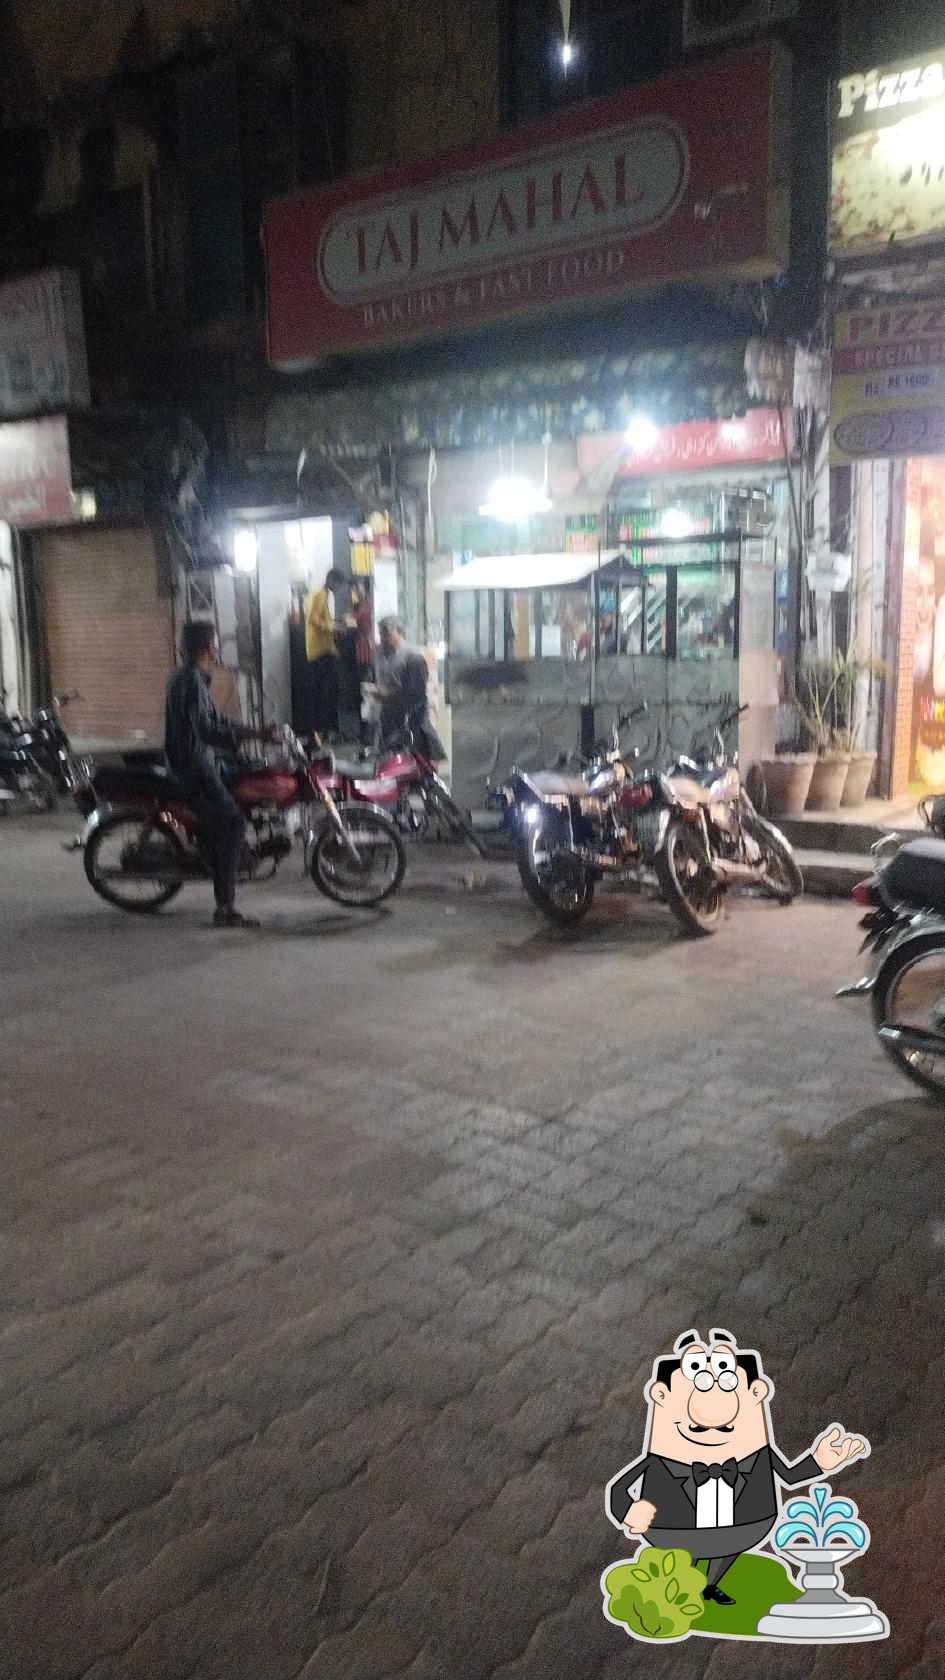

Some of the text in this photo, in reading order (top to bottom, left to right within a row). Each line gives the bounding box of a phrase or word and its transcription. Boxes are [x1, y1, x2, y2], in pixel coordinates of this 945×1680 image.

[837, 61, 945, 118] Pizza
[345, 154, 645, 275] TAJ MAHAL
[479, 267, 534, 300] FAST
[547, 247, 626, 285] FOOD
